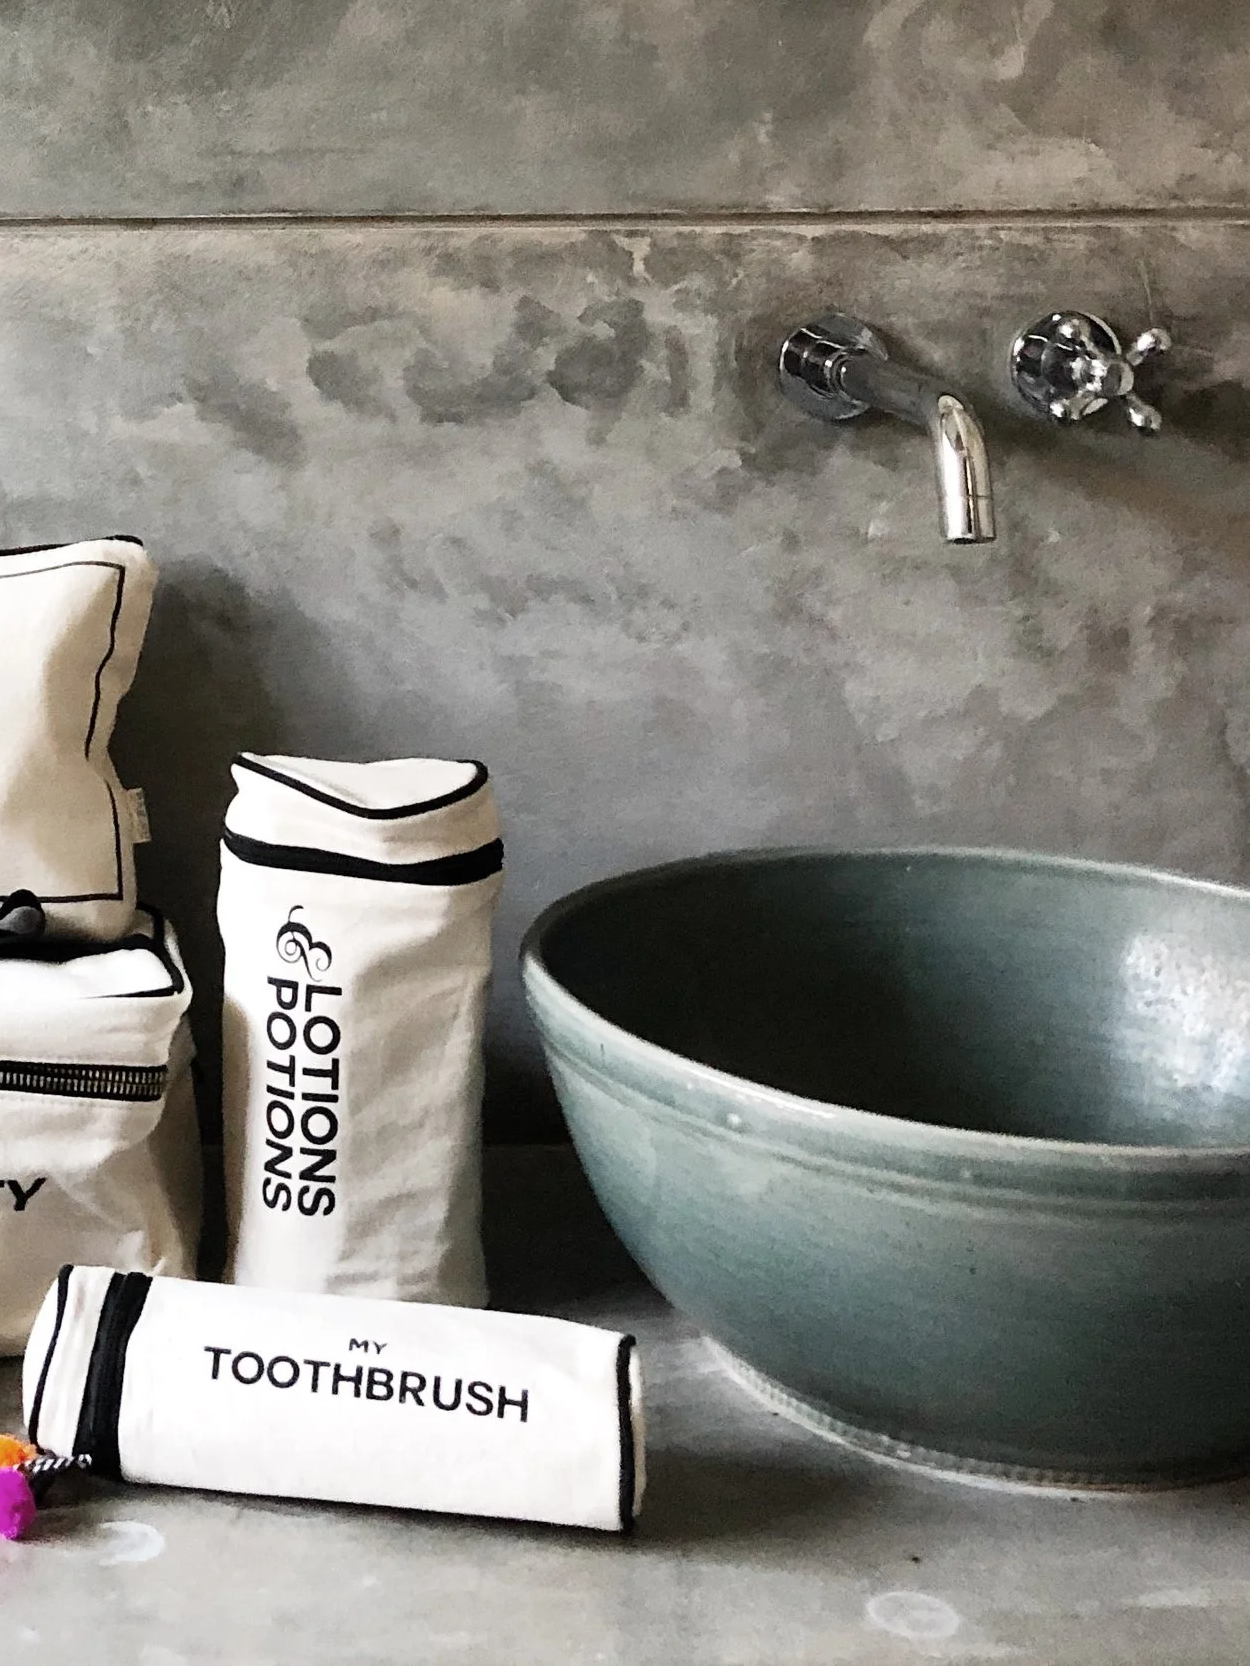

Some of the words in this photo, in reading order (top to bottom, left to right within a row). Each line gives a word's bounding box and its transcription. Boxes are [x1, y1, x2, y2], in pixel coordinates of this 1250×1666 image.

[262, 976, 299, 1212] POTIONS
[297, 984, 342, 1216] LOTIONS
[204, 1346, 529, 1422] TOOTHBRUSH
[349, 1338, 387, 1355] MY
